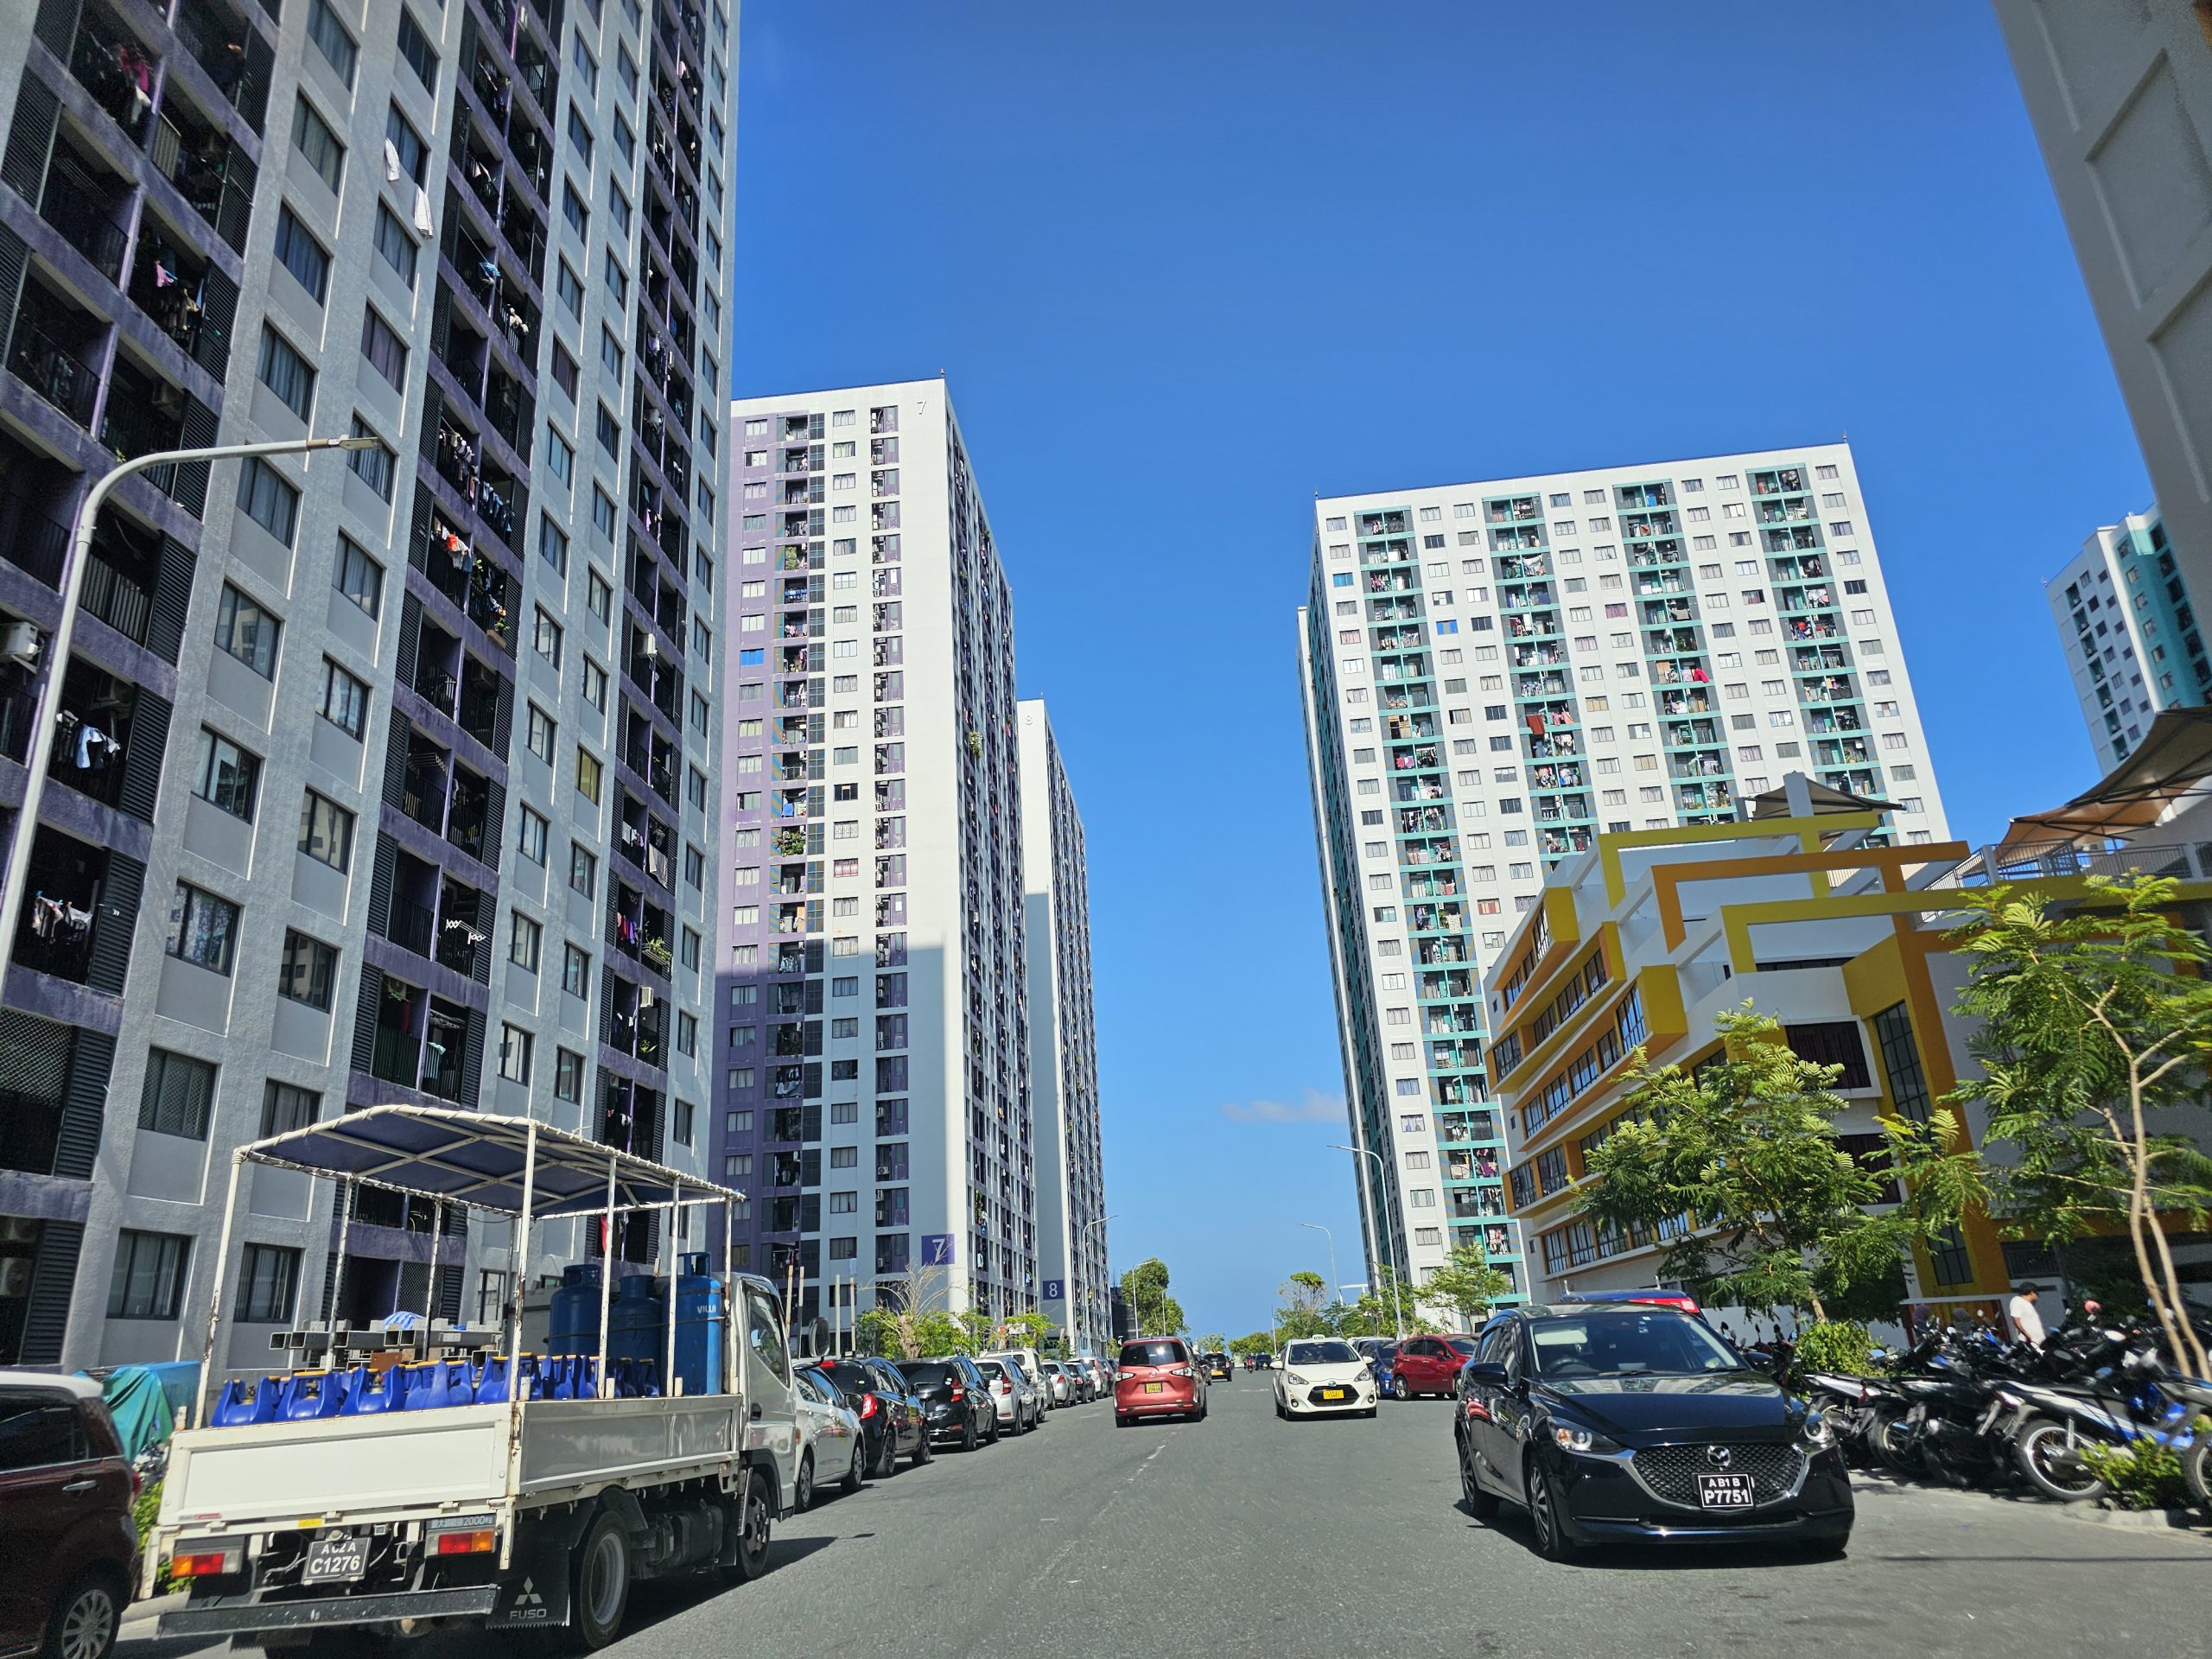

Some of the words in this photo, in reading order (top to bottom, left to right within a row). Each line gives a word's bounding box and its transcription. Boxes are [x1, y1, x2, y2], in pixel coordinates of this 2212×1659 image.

[916, 400, 927, 416] 7
[1025, 715, 1033, 726] 8
[932, 1238, 945, 1262] 7
[1049, 1282, 1058, 1298] 8
[696, 1305, 717, 1314] VILLA
[1704, 1489, 1750, 1503] P7751
[310, 1554, 361, 1574] C1276
[509, 1608, 547, 1621] FUSO
